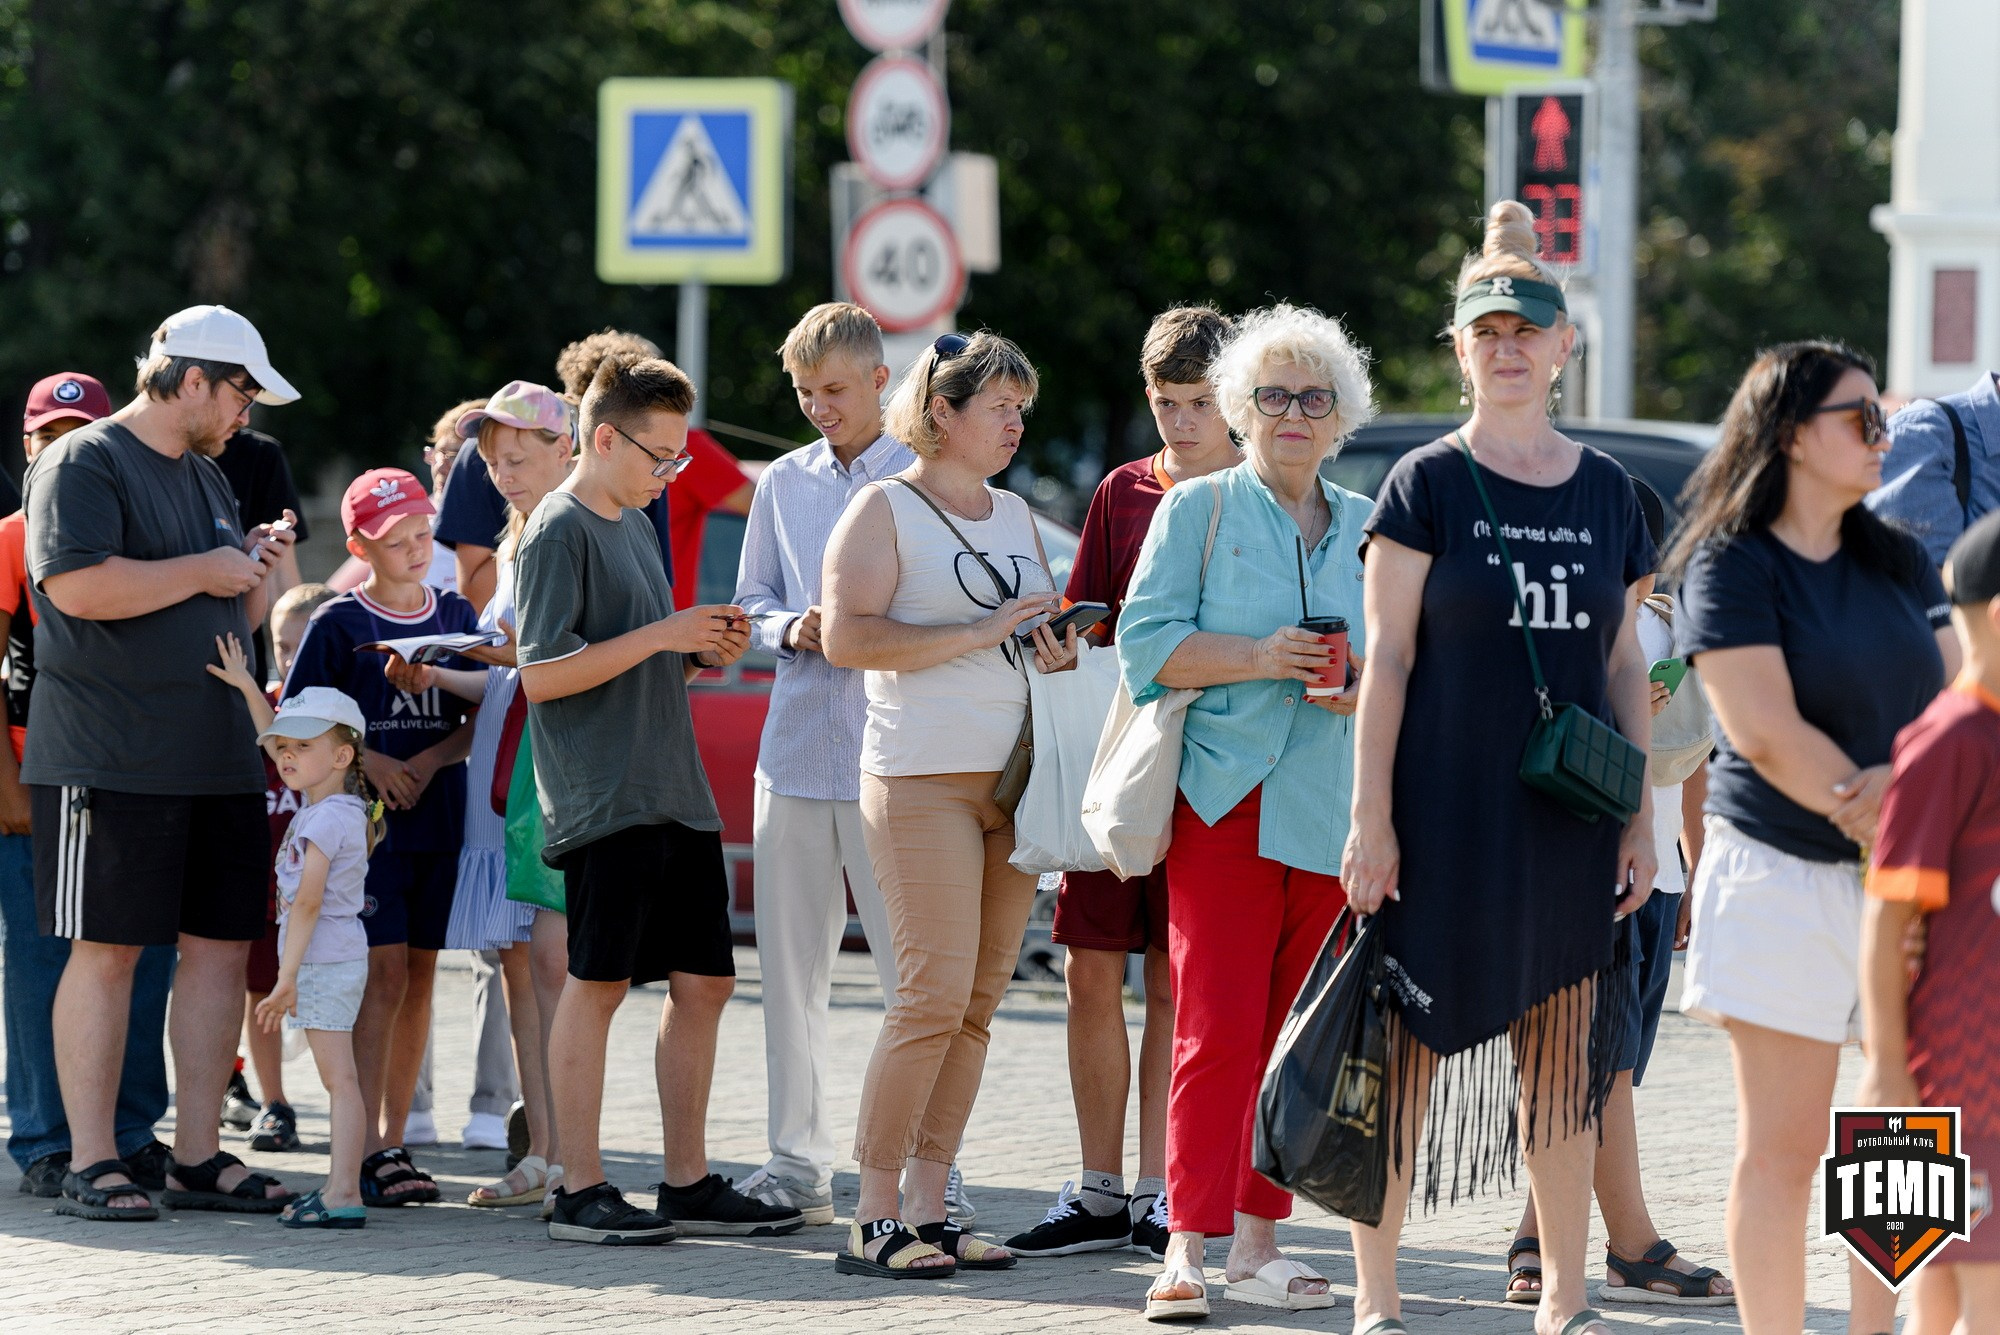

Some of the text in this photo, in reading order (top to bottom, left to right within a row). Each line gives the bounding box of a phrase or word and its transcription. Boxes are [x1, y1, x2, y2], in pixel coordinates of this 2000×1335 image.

[868, 238, 940, 295] 40
[1490, 276, 1515, 296] R
[1499, 522, 1546, 542] started
[1548, 527, 1577, 544] with
[401, 719, 423, 730] LIVE
